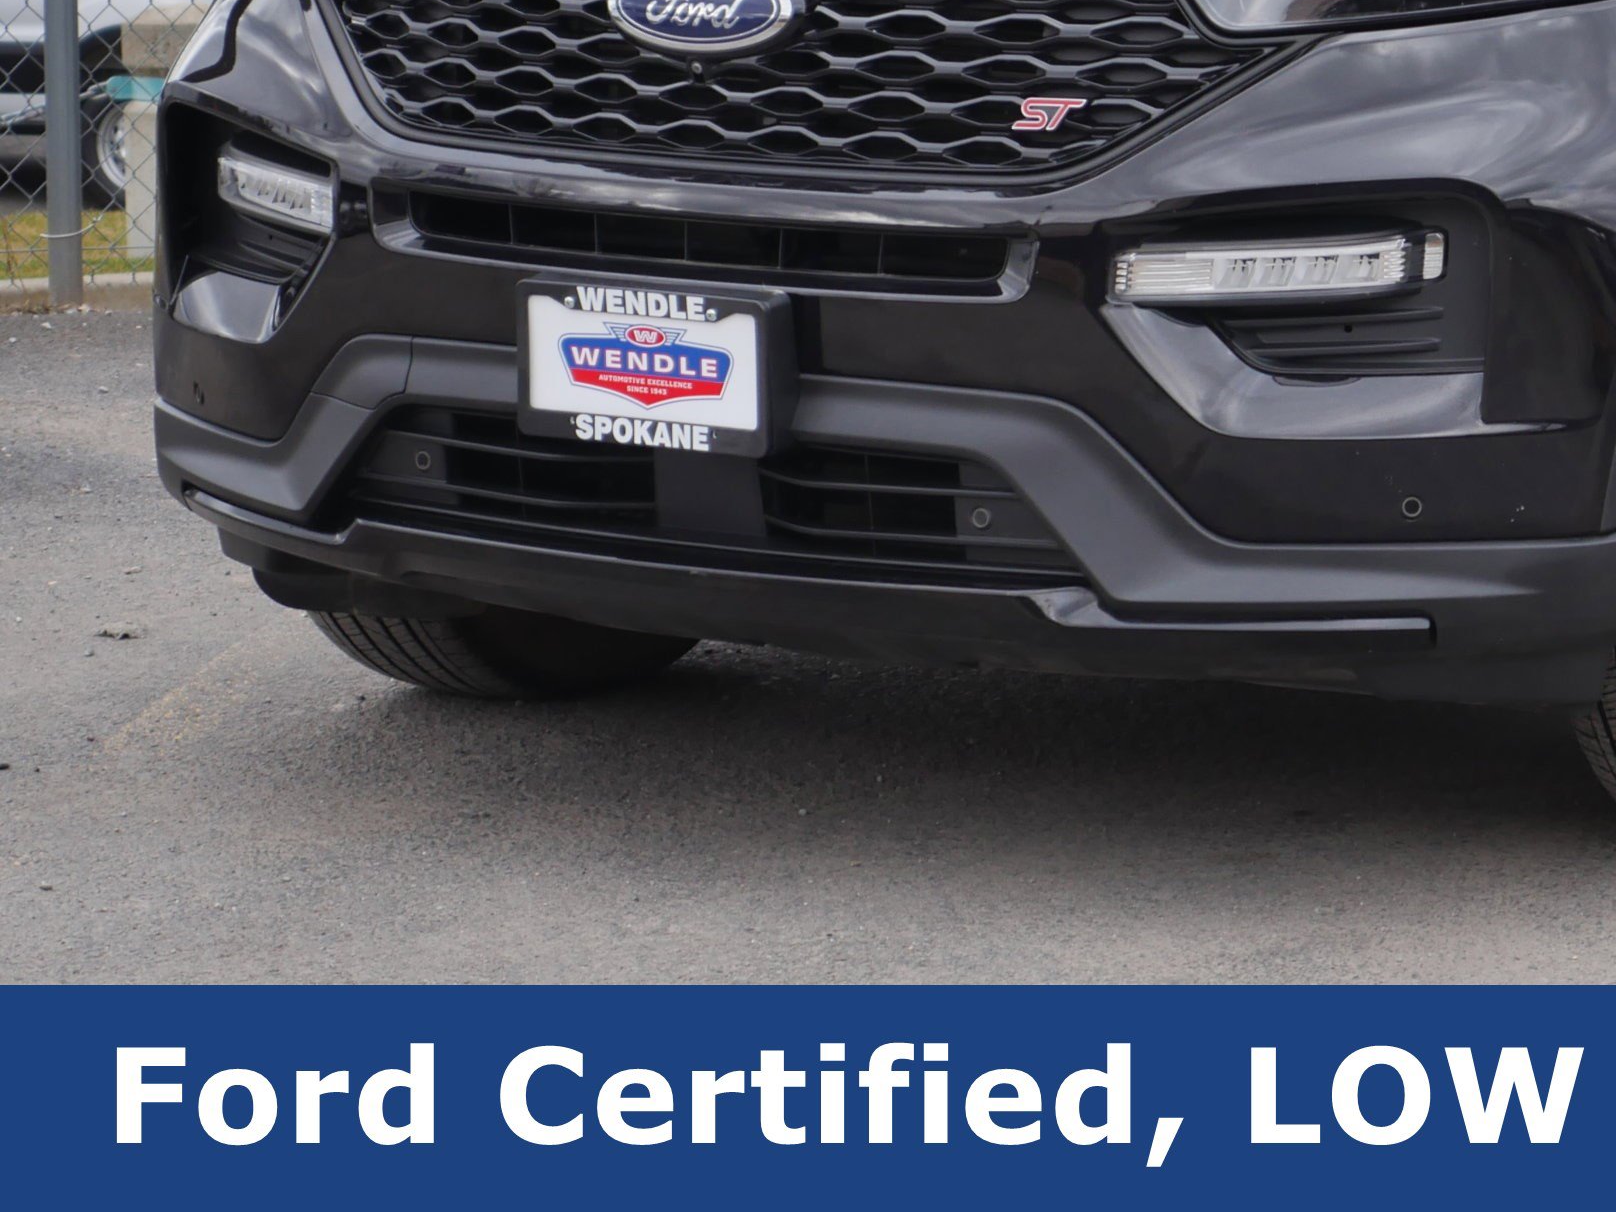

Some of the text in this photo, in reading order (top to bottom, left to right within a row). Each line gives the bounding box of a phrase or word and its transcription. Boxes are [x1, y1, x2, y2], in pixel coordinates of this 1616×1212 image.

[1011, 96, 1087, 132] ST
[576, 286, 707, 322] WENDLE
[570, 346, 719, 378] WENDLE
[598, 374, 693, 390] AUTOMOTIVE EXCELLENCE
[626, 385, 667, 396] SINCE 1943
[575, 413, 710, 452] SPOKANE
